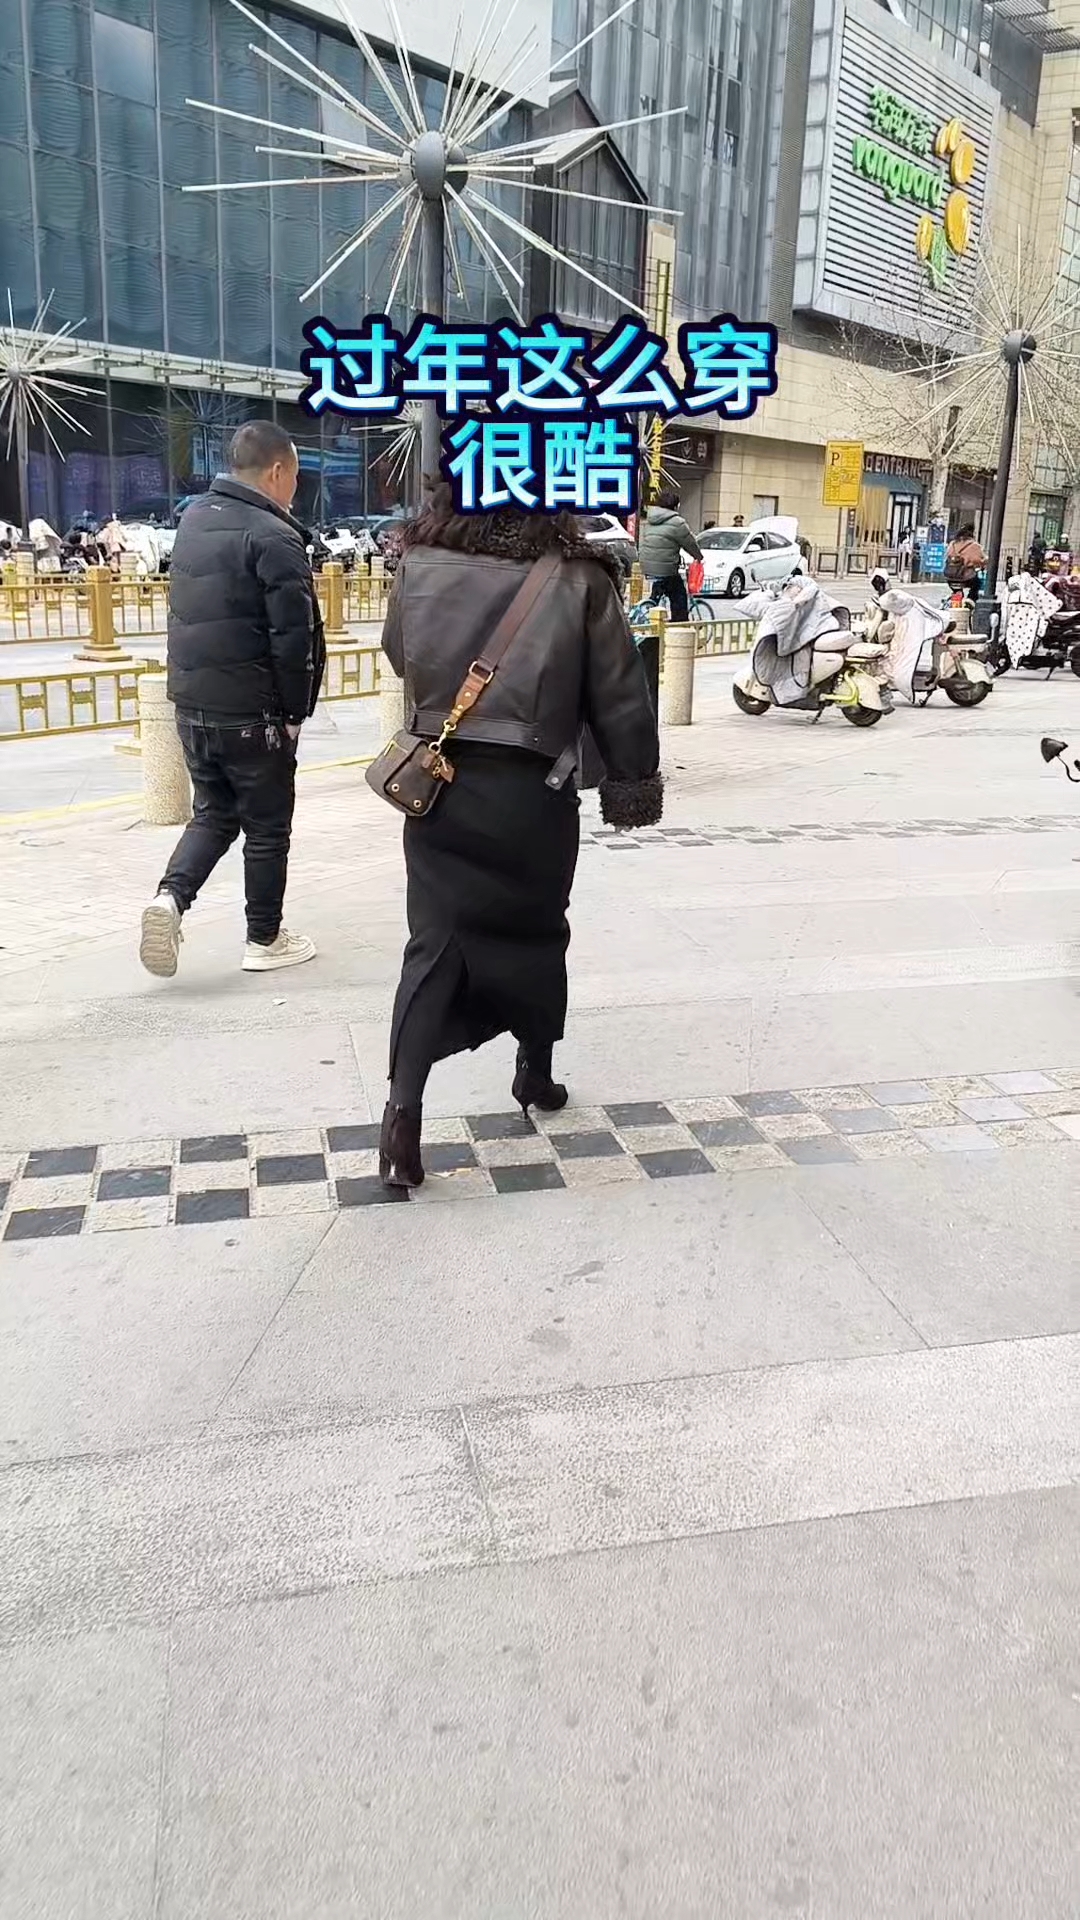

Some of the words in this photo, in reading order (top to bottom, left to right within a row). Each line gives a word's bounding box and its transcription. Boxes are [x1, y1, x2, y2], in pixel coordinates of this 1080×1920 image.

[853, 136, 944, 208] vanguard
[831, 451, 840, 466] P
[875, 455, 926, 478] ENTRANC
